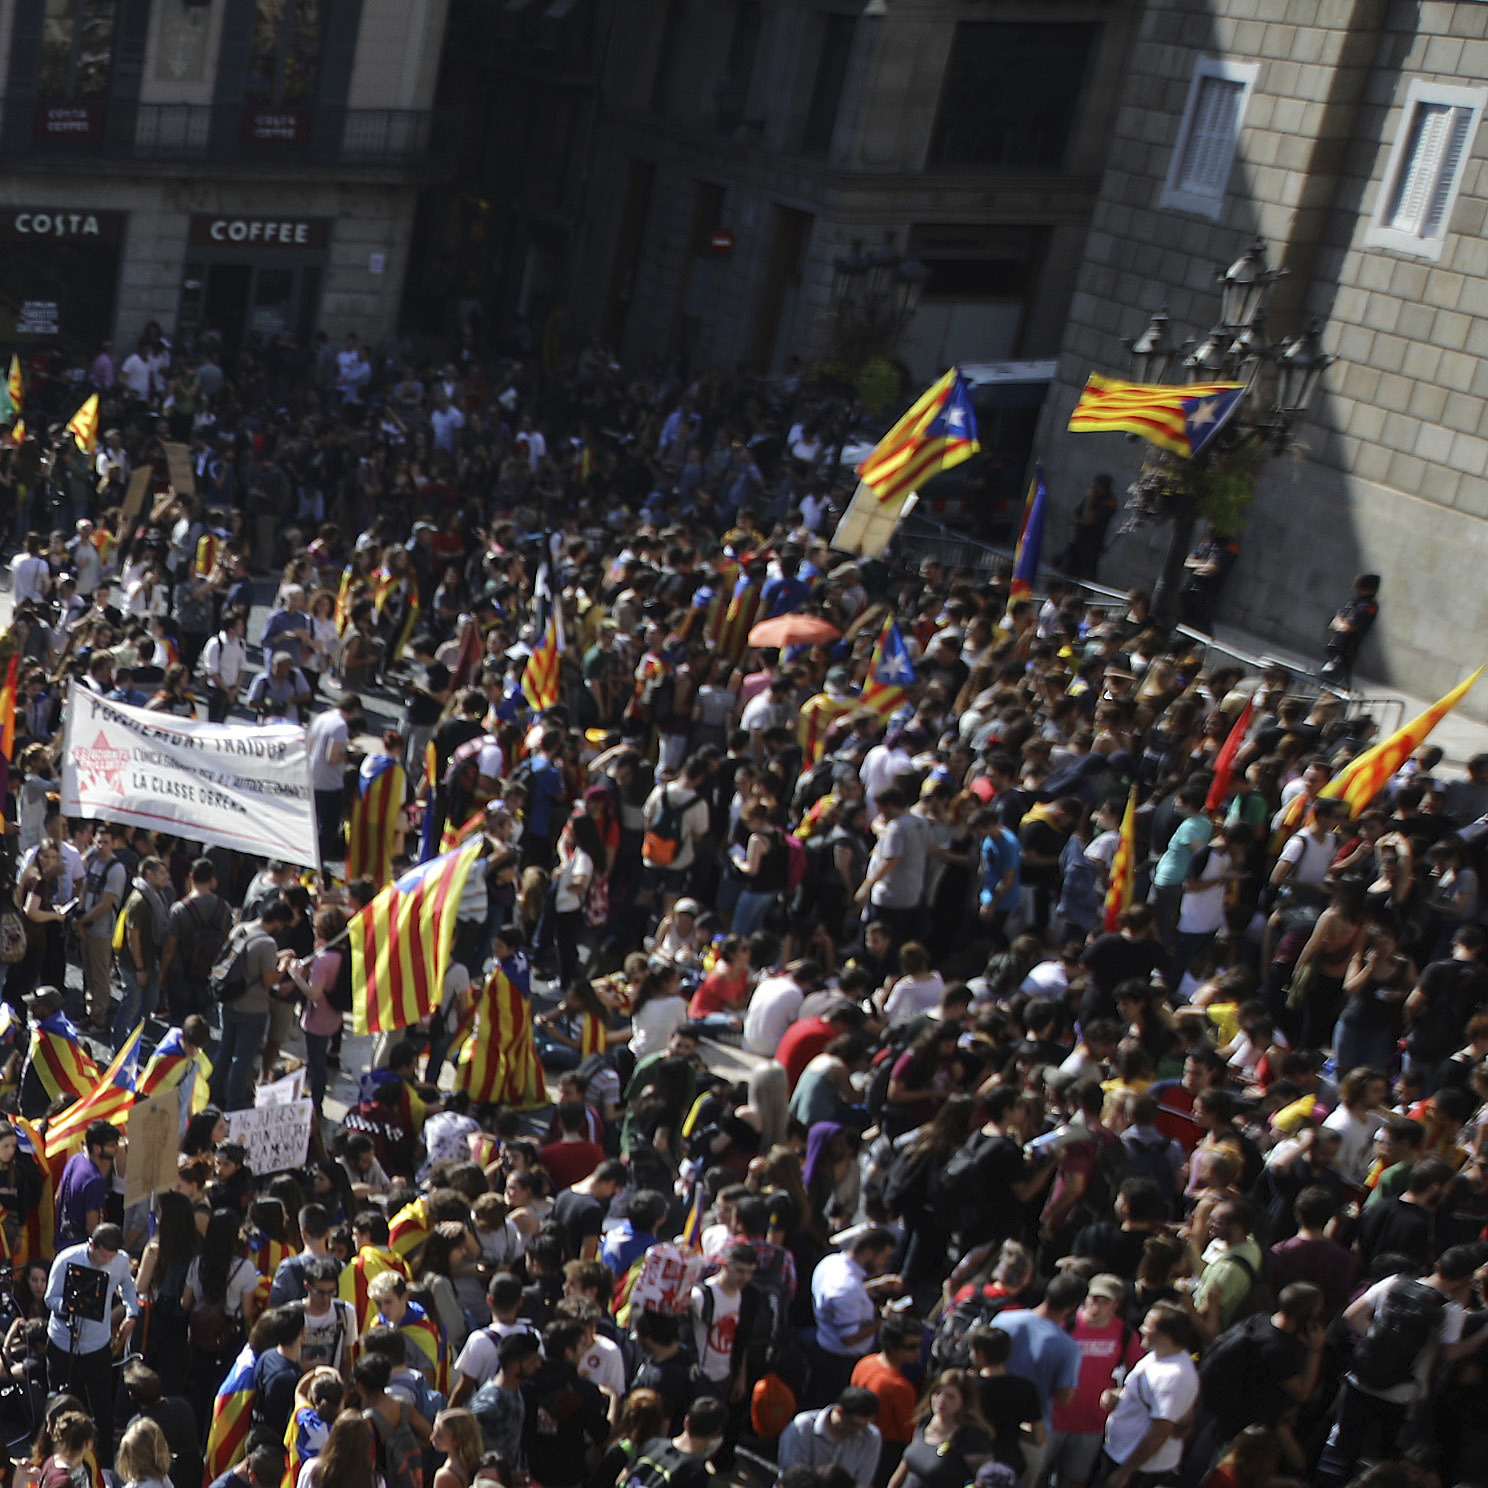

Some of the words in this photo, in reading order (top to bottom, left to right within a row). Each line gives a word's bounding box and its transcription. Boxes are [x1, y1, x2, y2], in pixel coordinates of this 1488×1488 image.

[15, 212, 101, 237] COSTA
[210, 220, 310, 245] COFFEE
[151, 776, 195, 802] CLASSE
